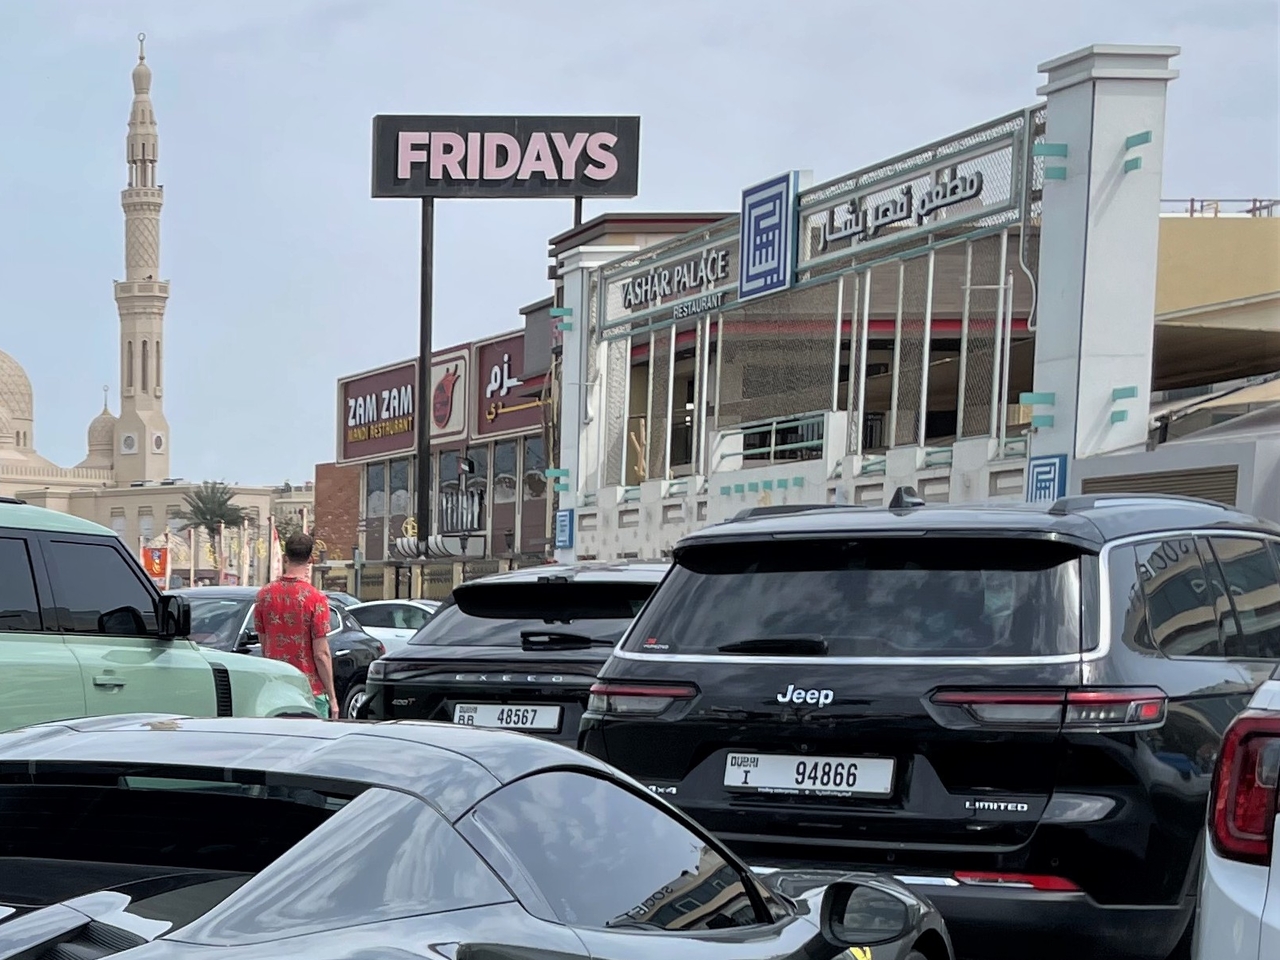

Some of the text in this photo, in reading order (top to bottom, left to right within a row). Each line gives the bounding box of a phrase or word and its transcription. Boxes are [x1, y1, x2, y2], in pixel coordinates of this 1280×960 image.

[398, 132, 618, 180] FRIDAYS
[918, 165, 982, 218] مطعم
[868, 184, 913, 235] قصر
[621, 250, 727, 308] YASHAR PALACE
[673, 293, 723, 319] RESTAURANT
[347, 384, 413, 427] ZAM ZAM
[347, 417, 413, 443] MANDI RESTAURANT
[777, 684, 834, 707] Jeep
[497, 708, 537, 725] 48567
[741, 770, 751, 785] I
[795, 761, 858, 787] 94866
[965, 800, 1028, 812] LIMITED
